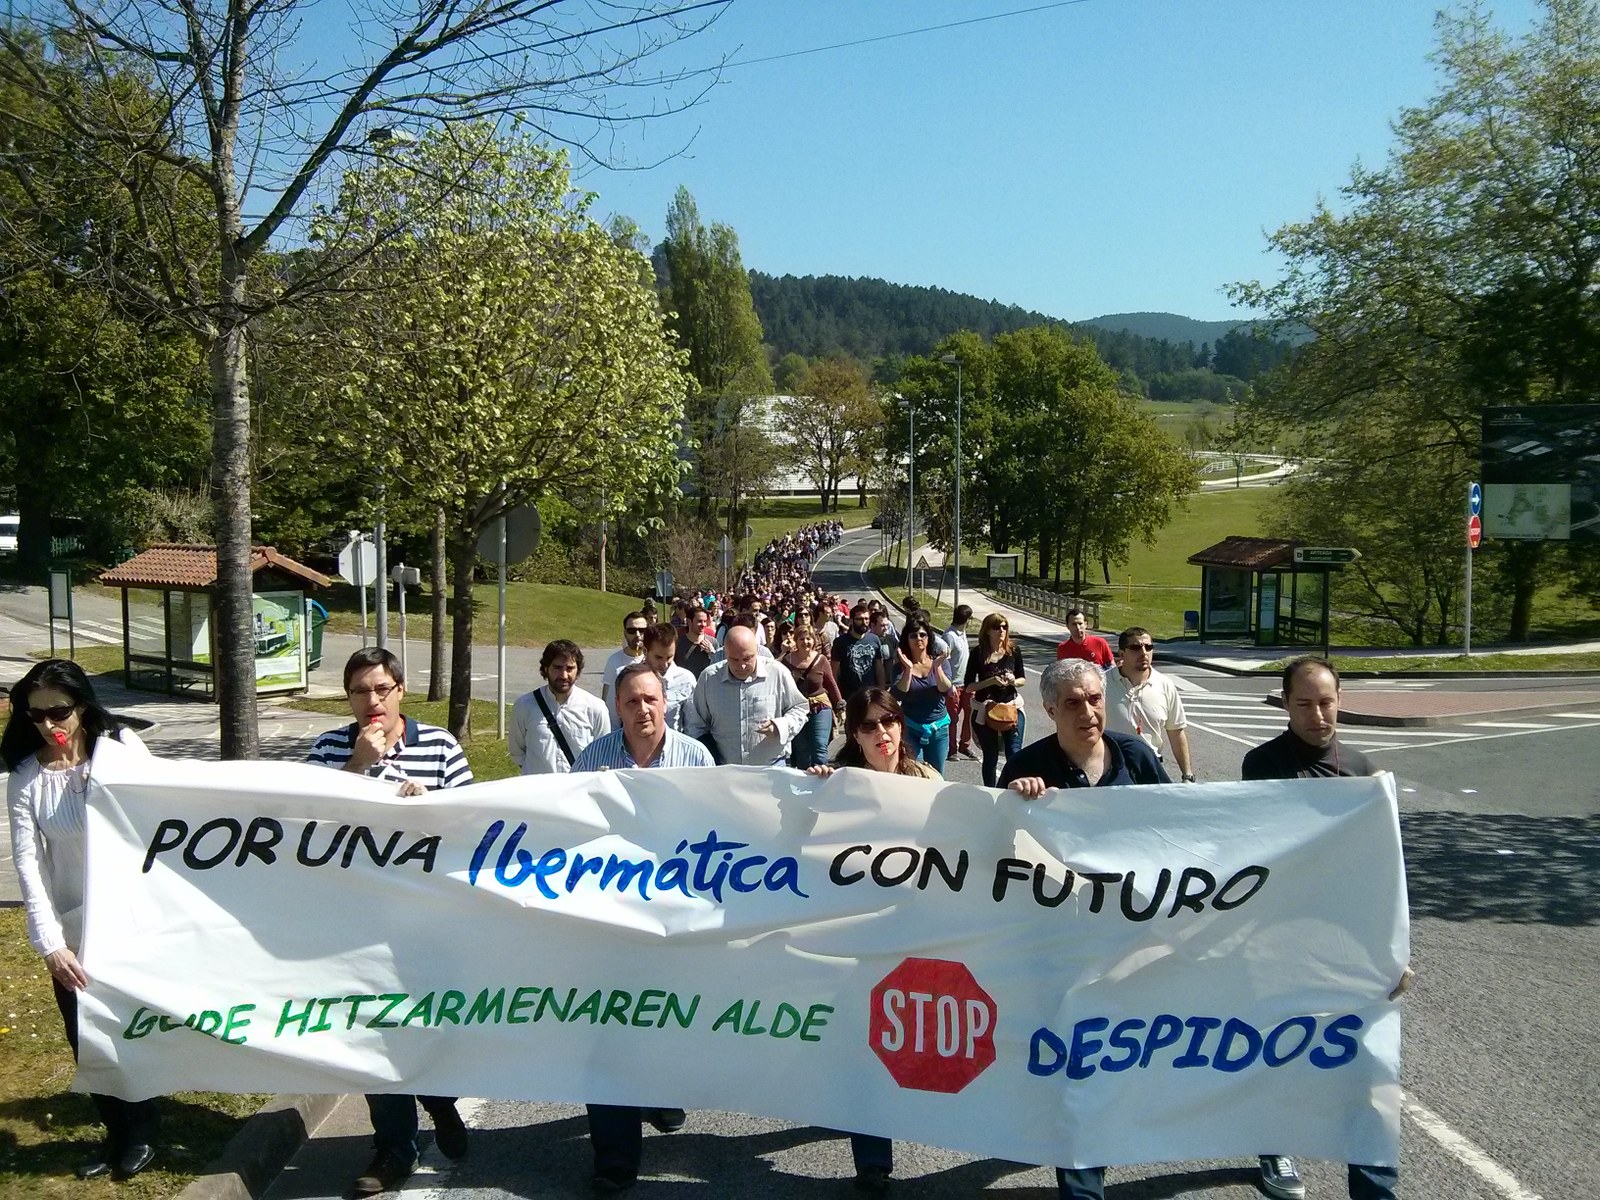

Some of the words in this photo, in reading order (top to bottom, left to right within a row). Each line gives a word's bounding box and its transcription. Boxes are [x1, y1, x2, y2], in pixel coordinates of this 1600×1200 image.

[143, 817, 284, 873] POR
[297, 820, 442, 873] UNA
[469, 820, 810, 904] Ibermática
[829, 845, 969, 893] CON
[993, 857, 1270, 923] FUTURO
[275, 986, 701, 1037] HITZARMENAREN
[711, 998, 835, 1042] ALDE
[881, 989, 991, 1060] STOP
[1027, 1014, 1364, 1081] DESPIDOS
